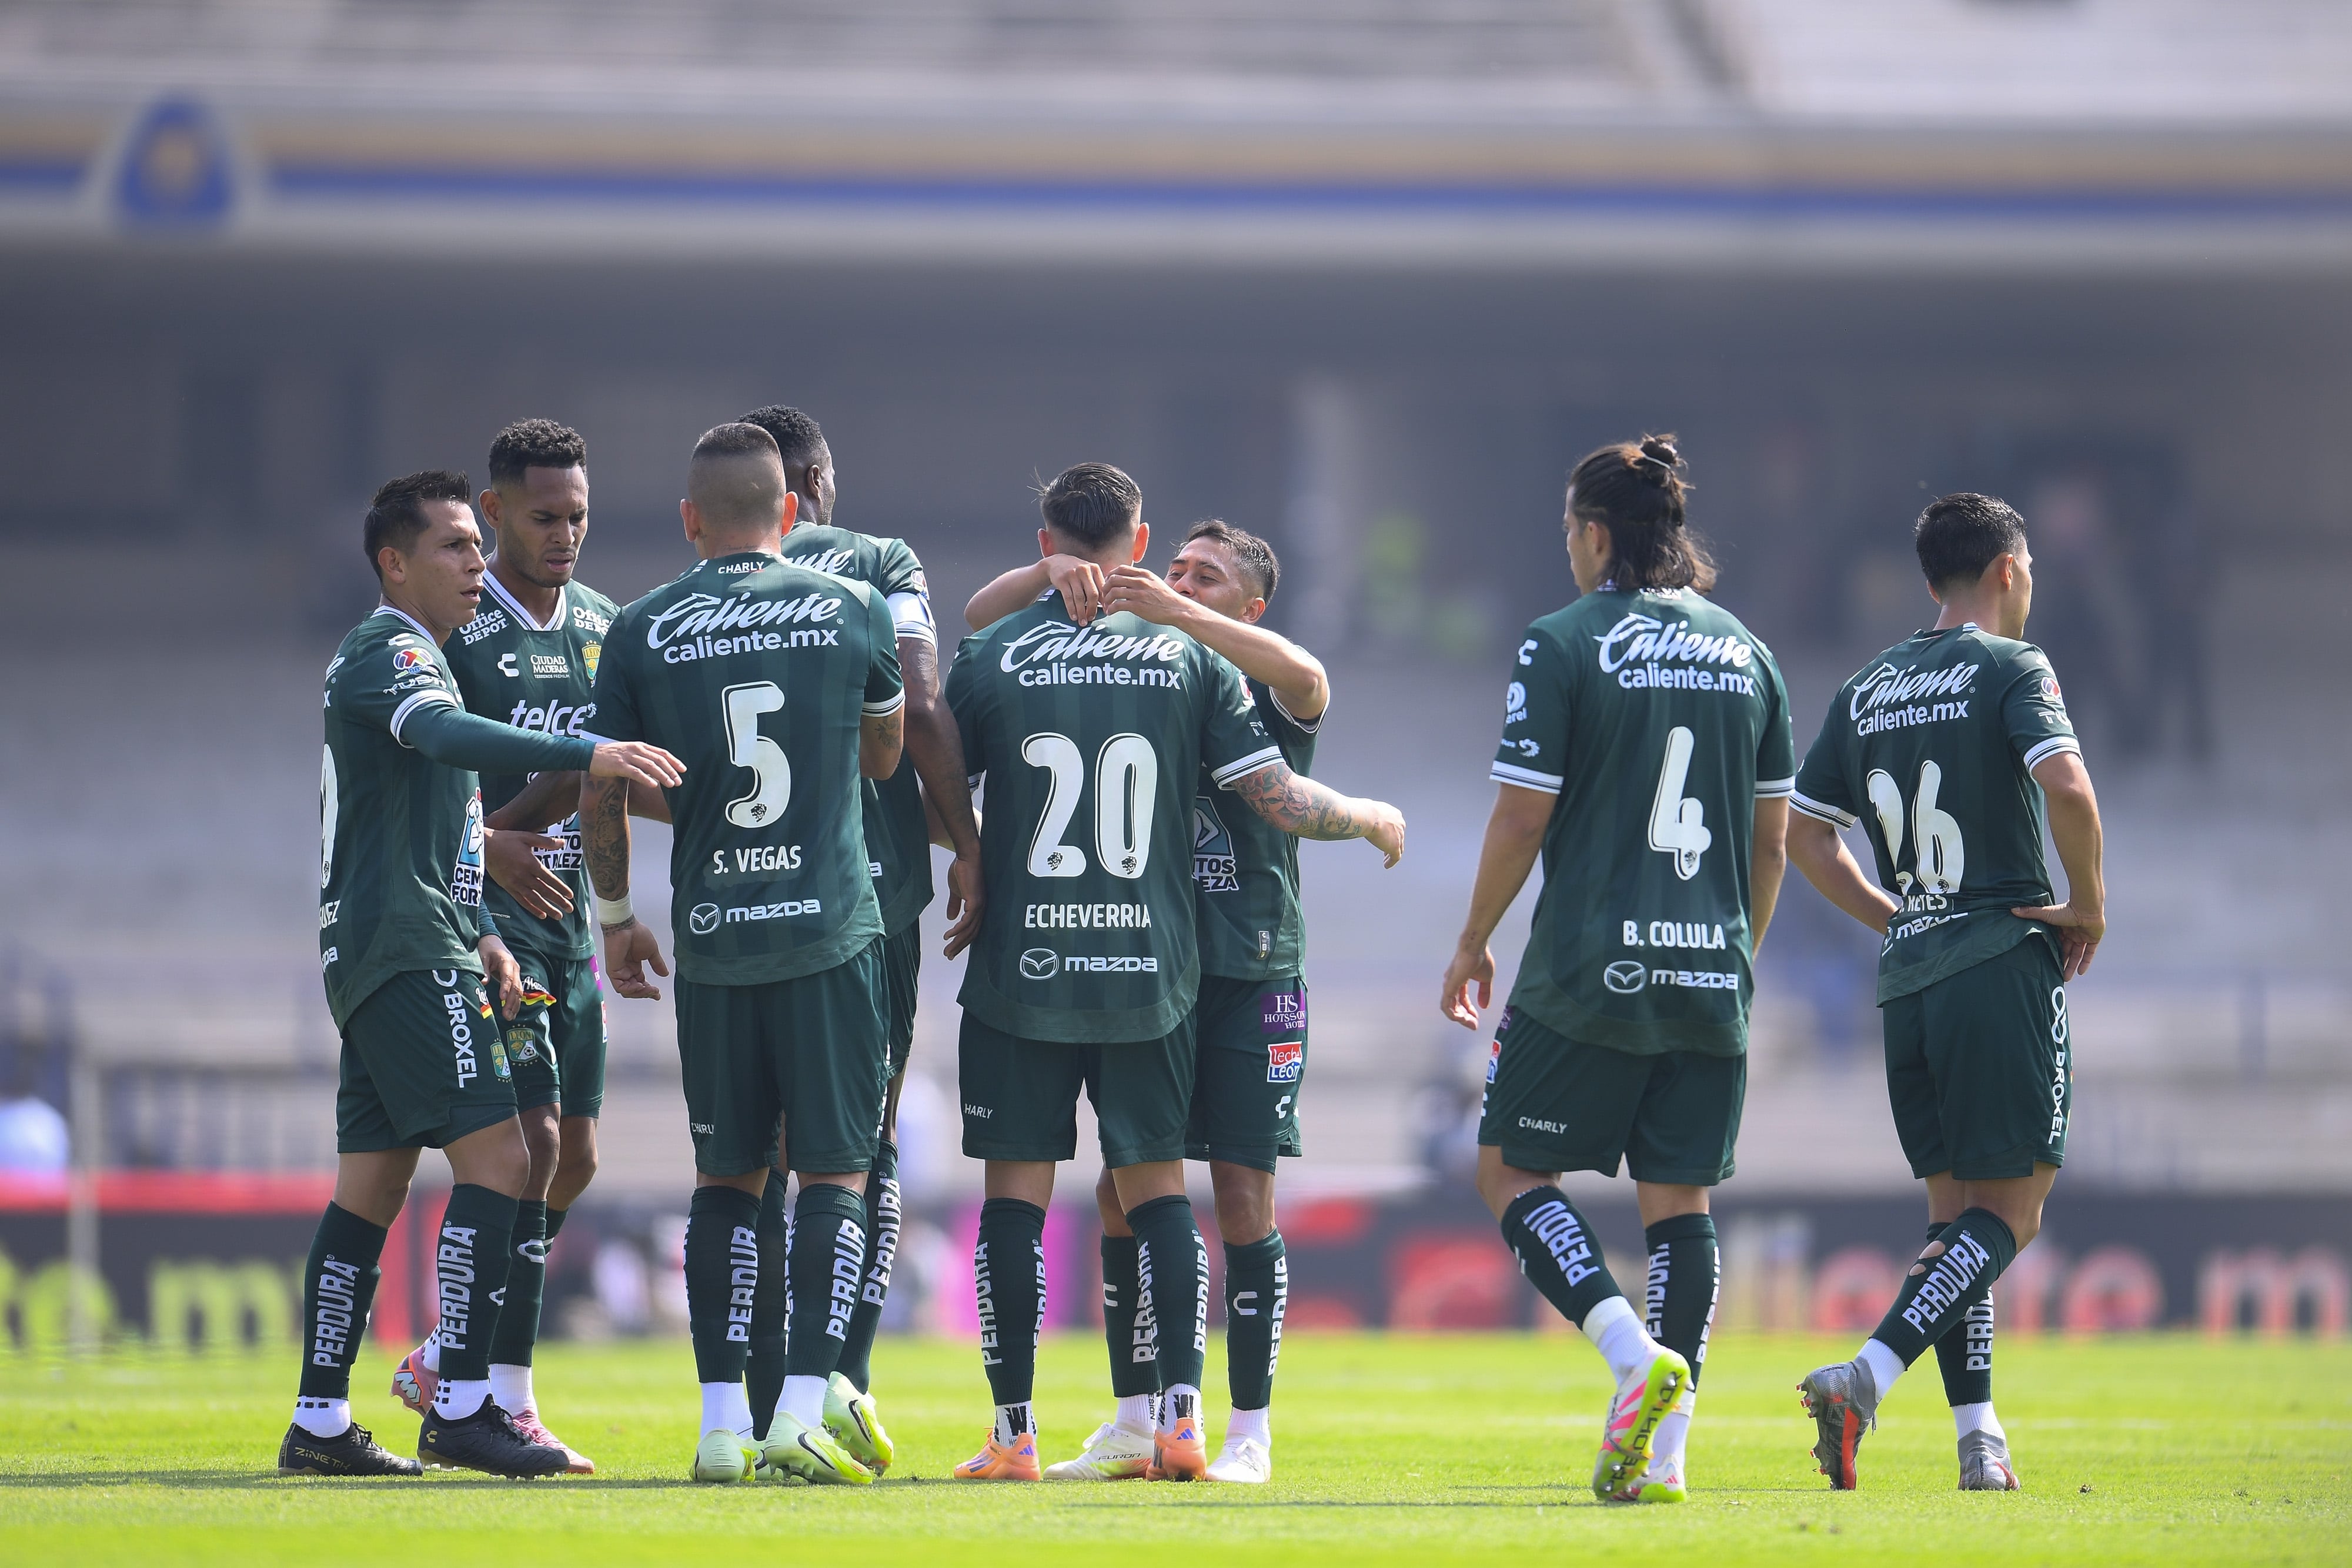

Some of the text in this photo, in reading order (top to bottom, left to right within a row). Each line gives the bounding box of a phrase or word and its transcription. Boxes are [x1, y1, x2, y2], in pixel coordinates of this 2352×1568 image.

[718, 561, 764, 574] CHARLY
[463, 618, 509, 646] DEPOT
[573, 606, 612, 629] Offic
[574, 618, 609, 636] DEPO
[647, 591, 843, 649] Caliente
[530, 655, 566, 665] CIUDAD
[664, 626, 839, 664] caliente.mx
[1000, 620, 1184, 673] Caliente
[1593, 612, 1752, 674] Caliente
[533, 664, 569, 674] MADERAS
[1018, 663, 1181, 690] caliente.mx
[1618, 663, 1756, 697] caliente.mx
[1850, 662, 1979, 720] Caliente
[510, 700, 587, 735] telce
[1857, 700, 1969, 737] caliente.mx
[721, 680, 791, 828] 5
[1021, 732, 1157, 878] 20
[1648, 726, 1712, 881] 4
[713, 845, 802, 874] S. VEGAS
[726, 899, 821, 923] mazda
[1024, 904, 1152, 928] ECHEVERRIA
[1623, 920, 1726, 950] B. COLULA
[1065, 956, 1158, 972] mazda
[1651, 969, 1739, 990] mazda
[1264, 1010, 1305, 1023] HOTSSON
[1275, 995, 1298, 1013] HS
[443, 994, 477, 1088] BROXEL
[964, 1103, 993, 1119] HARLY
[1518, 1116, 1567, 1134] CHARLY
[861, 1178, 901, 1308] PERDURA
[1522, 1201, 1601, 1288] PERDU
[439, 1226, 477, 1350] PERDURA
[726, 1226, 758, 1342] PERDUR
[825, 1219, 866, 1342] PERDUR
[1902, 1232, 1990, 1336] PERDURA
[313, 1259, 360, 1369] PERDURA
[974, 1241, 1003, 1366] PERDURA
[1268, 1255, 1288, 1377] PERDUR
